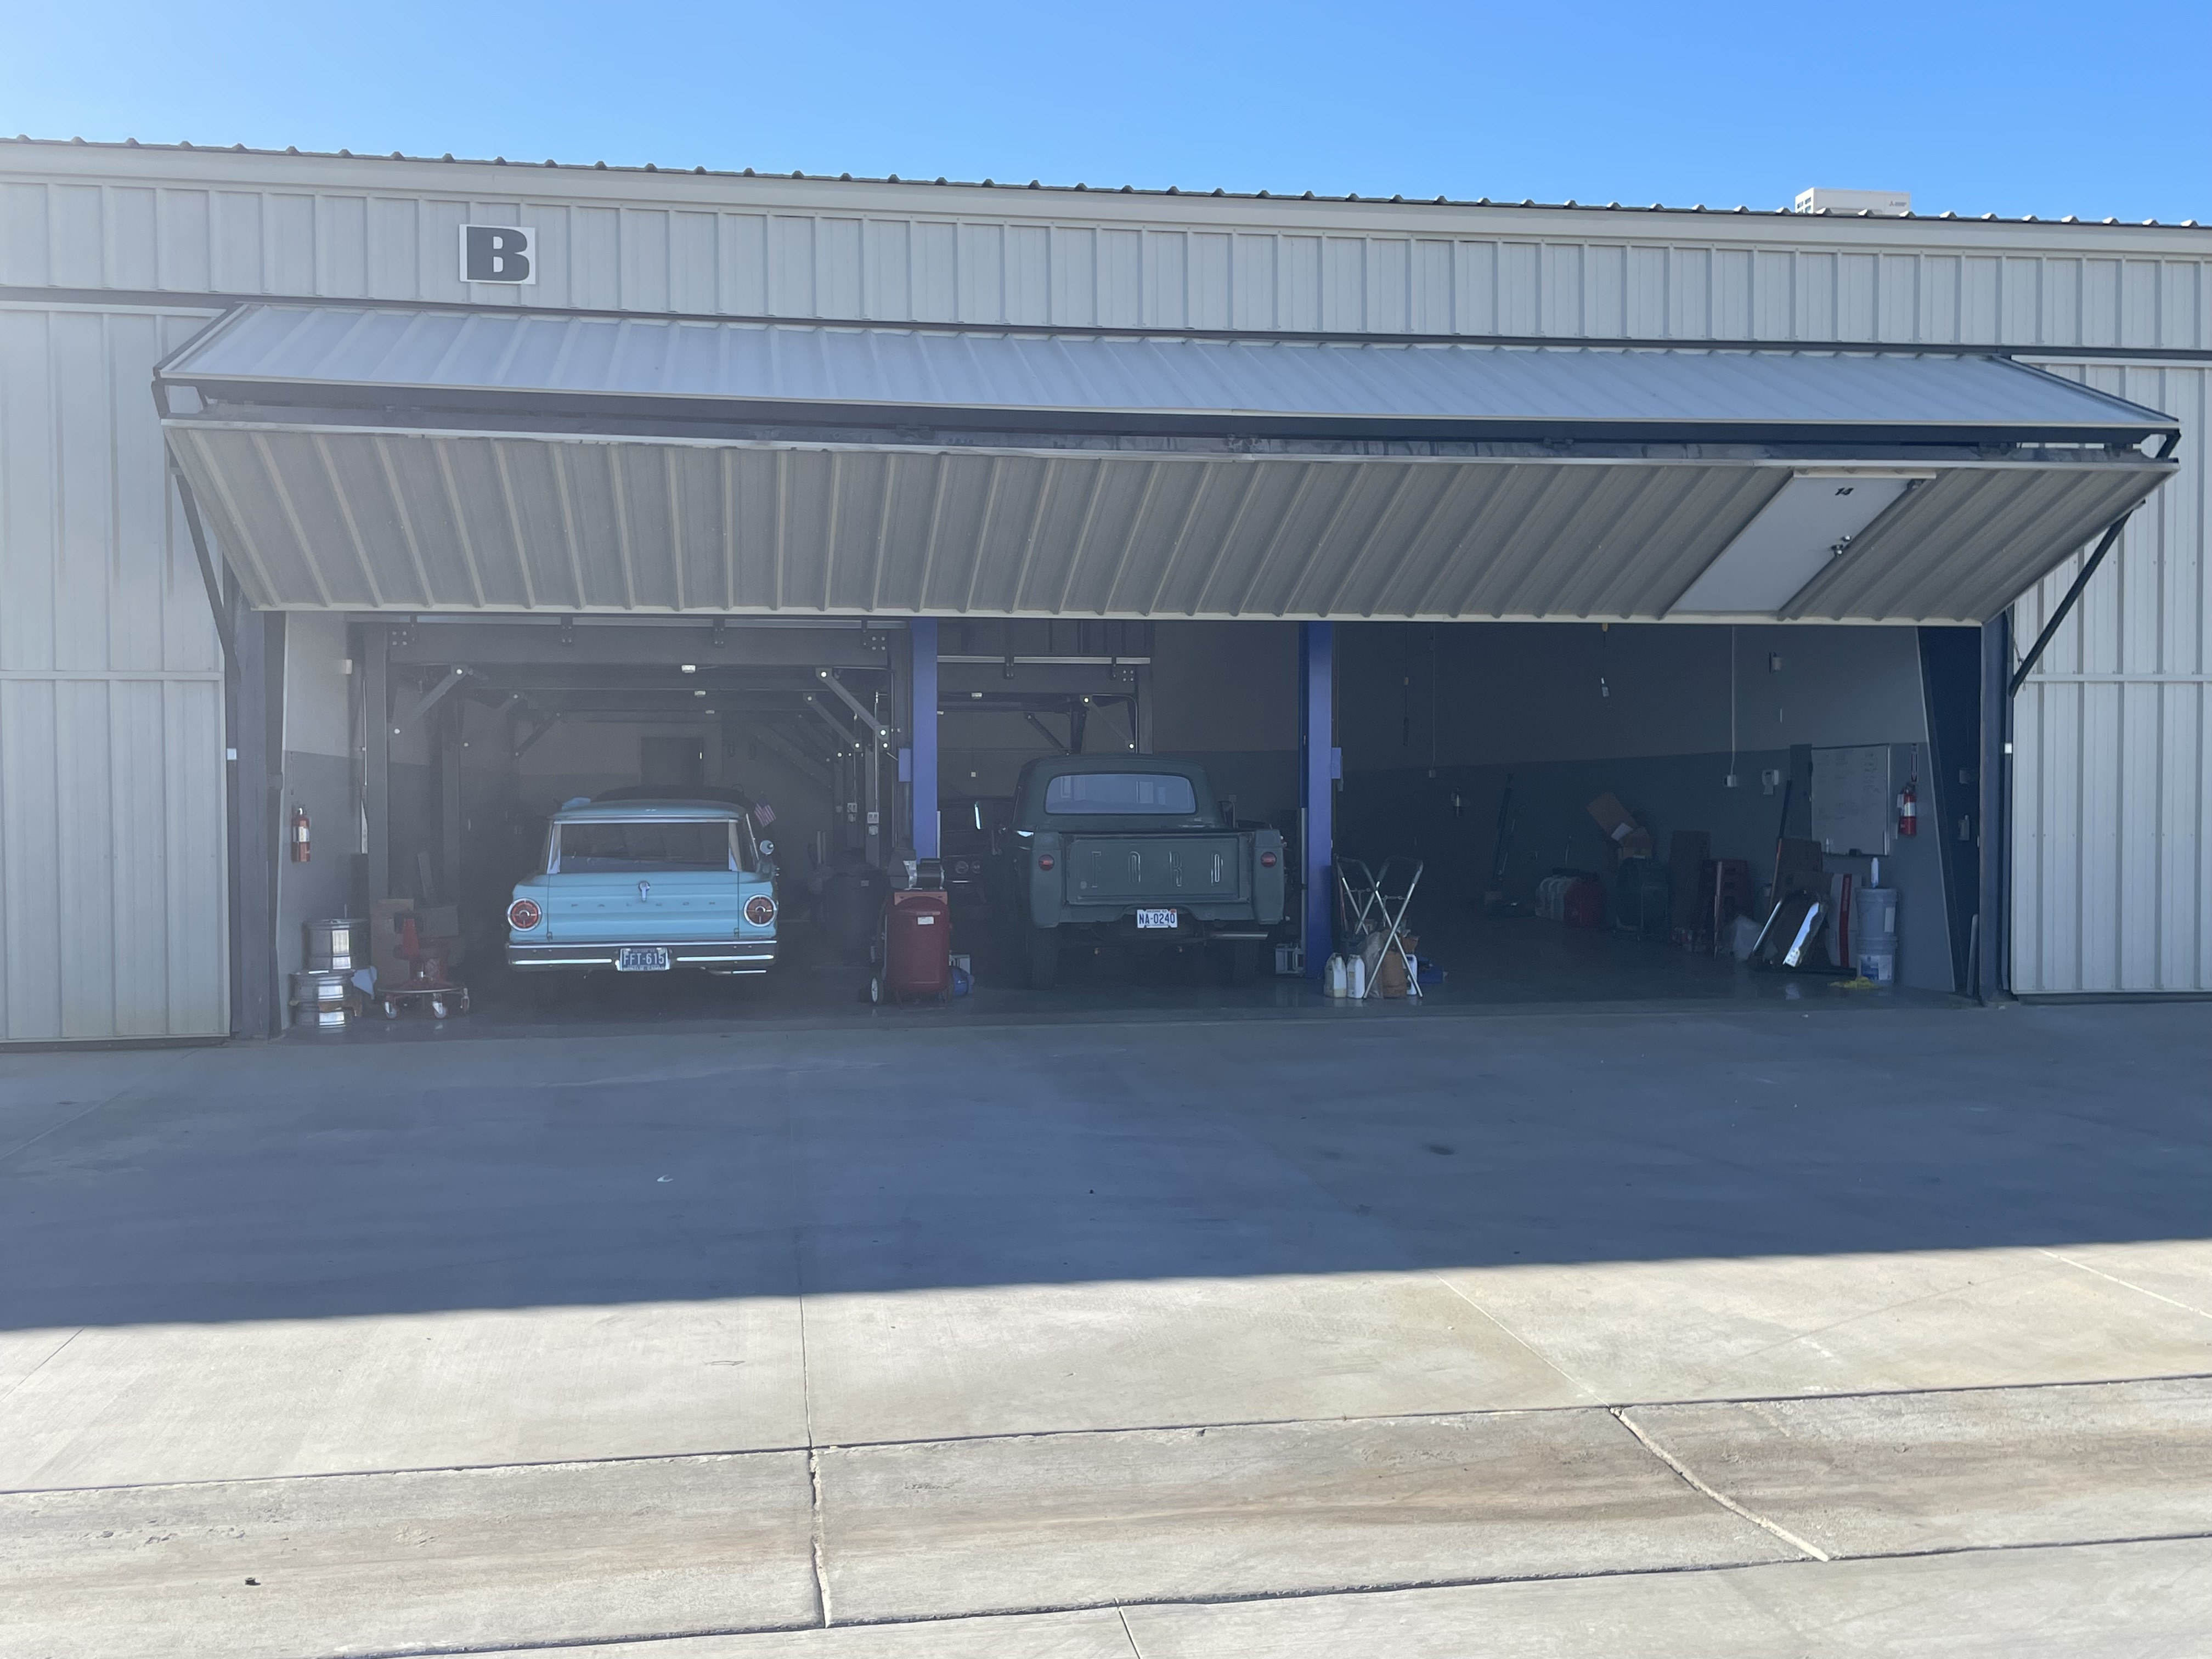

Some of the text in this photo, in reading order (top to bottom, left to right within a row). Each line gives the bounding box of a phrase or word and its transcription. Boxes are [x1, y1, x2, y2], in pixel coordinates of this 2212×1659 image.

[467, 226, 529, 281] B
[1092, 851, 1223, 887] FORD
[1139, 913, 1175, 924] NA-0240
[623, 953, 664, 965] FFT-615
